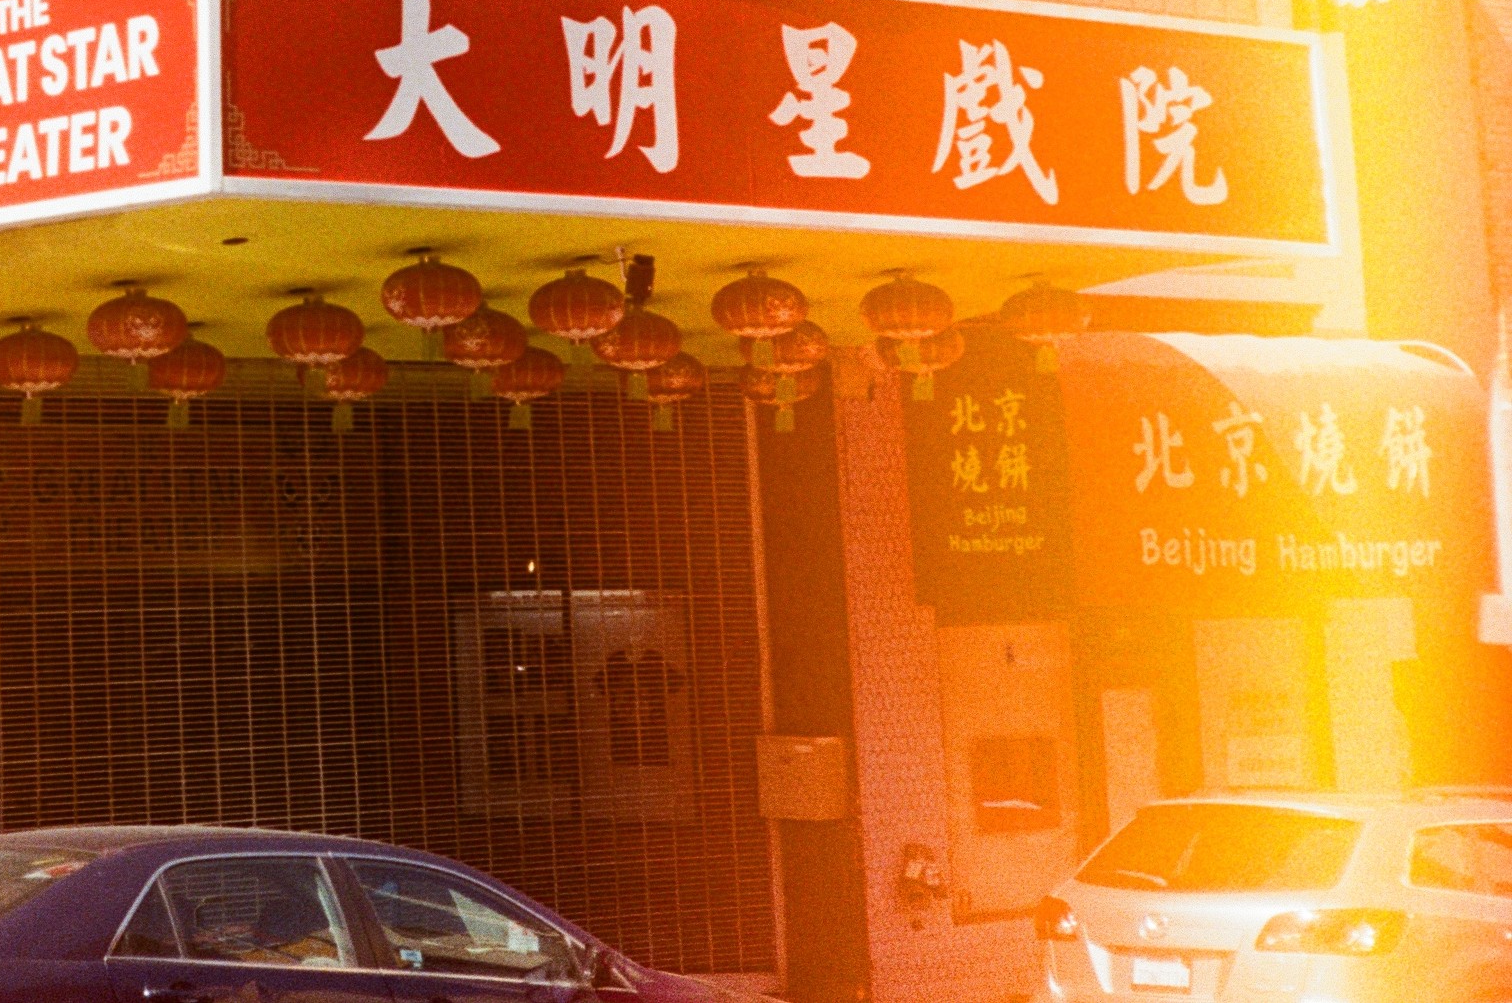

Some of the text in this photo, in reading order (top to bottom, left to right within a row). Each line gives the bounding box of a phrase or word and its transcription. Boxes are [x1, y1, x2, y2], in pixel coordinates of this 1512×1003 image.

[39, 15, 160, 96] STAR
[950, 389, 1028, 436] 北京
[1132, 402, 1434, 498] 北京燒餅
[963, 504, 1028, 533] Beijing
[948, 533, 1045, 556] Hamburger
[1140, 528, 1443, 576] Beijing Hamburger
